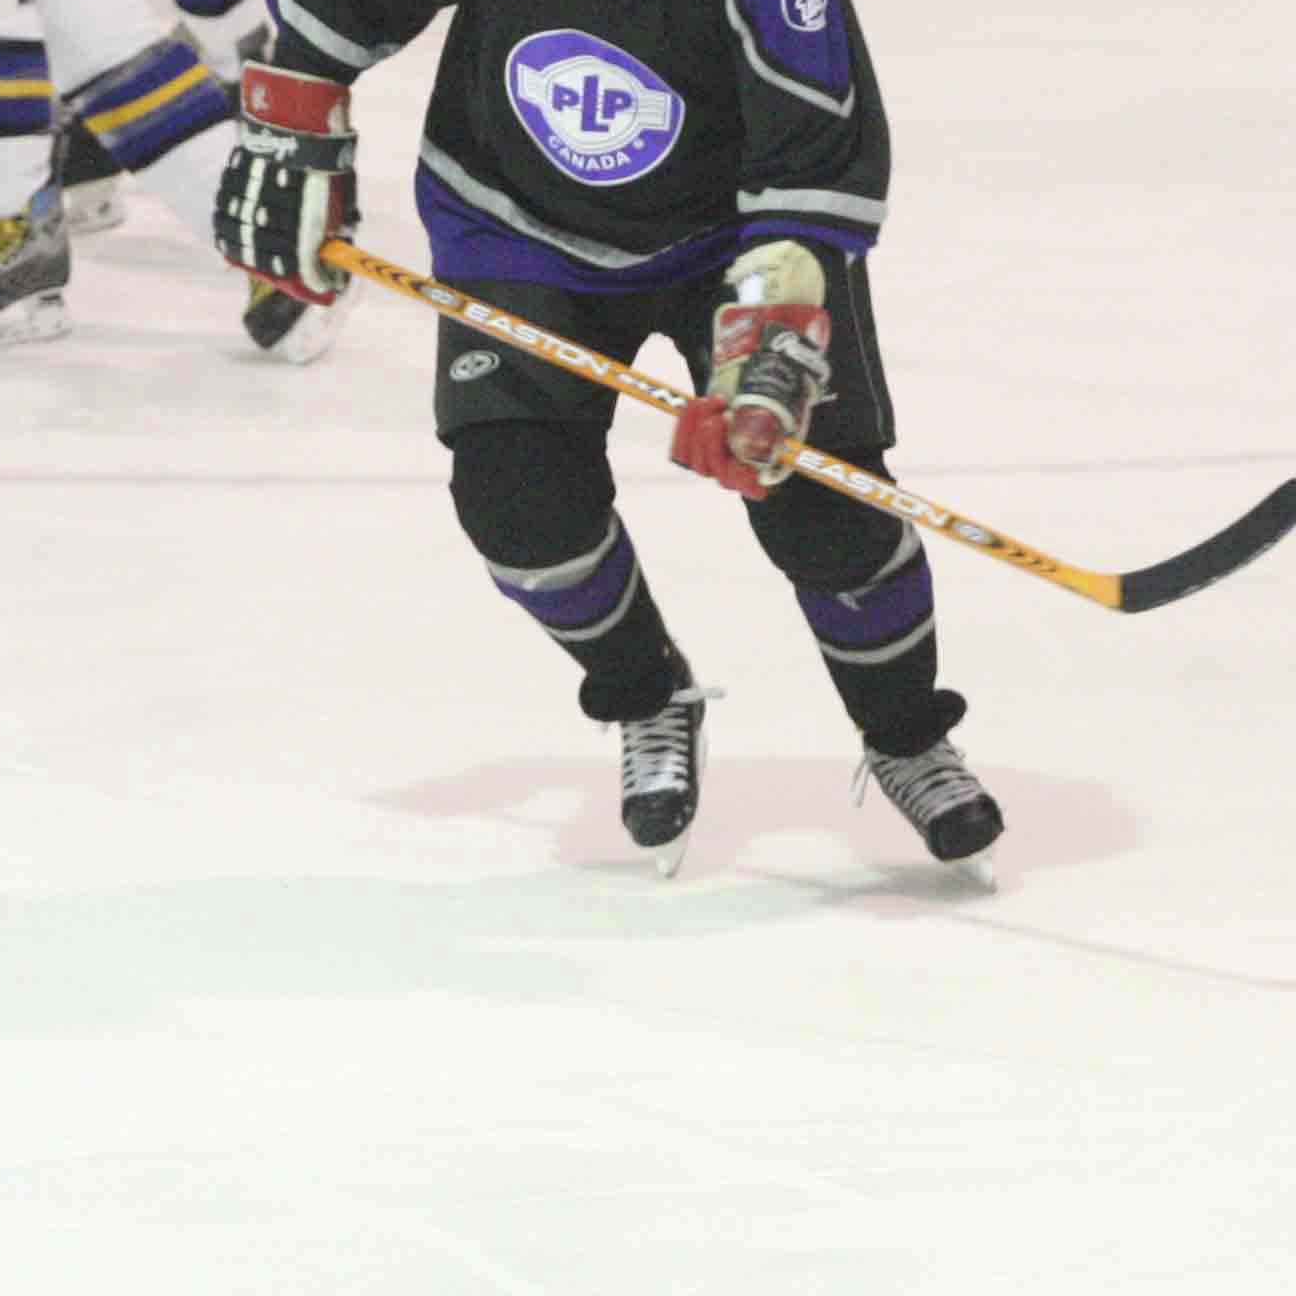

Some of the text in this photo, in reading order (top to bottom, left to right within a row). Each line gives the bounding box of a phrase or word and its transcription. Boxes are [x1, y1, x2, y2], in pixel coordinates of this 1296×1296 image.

[551, 74, 633, 133] PLP
[548, 135, 631, 171] CANADA
[464, 301, 612, 375] EASTON
[796, 449, 951, 528] EASTON
